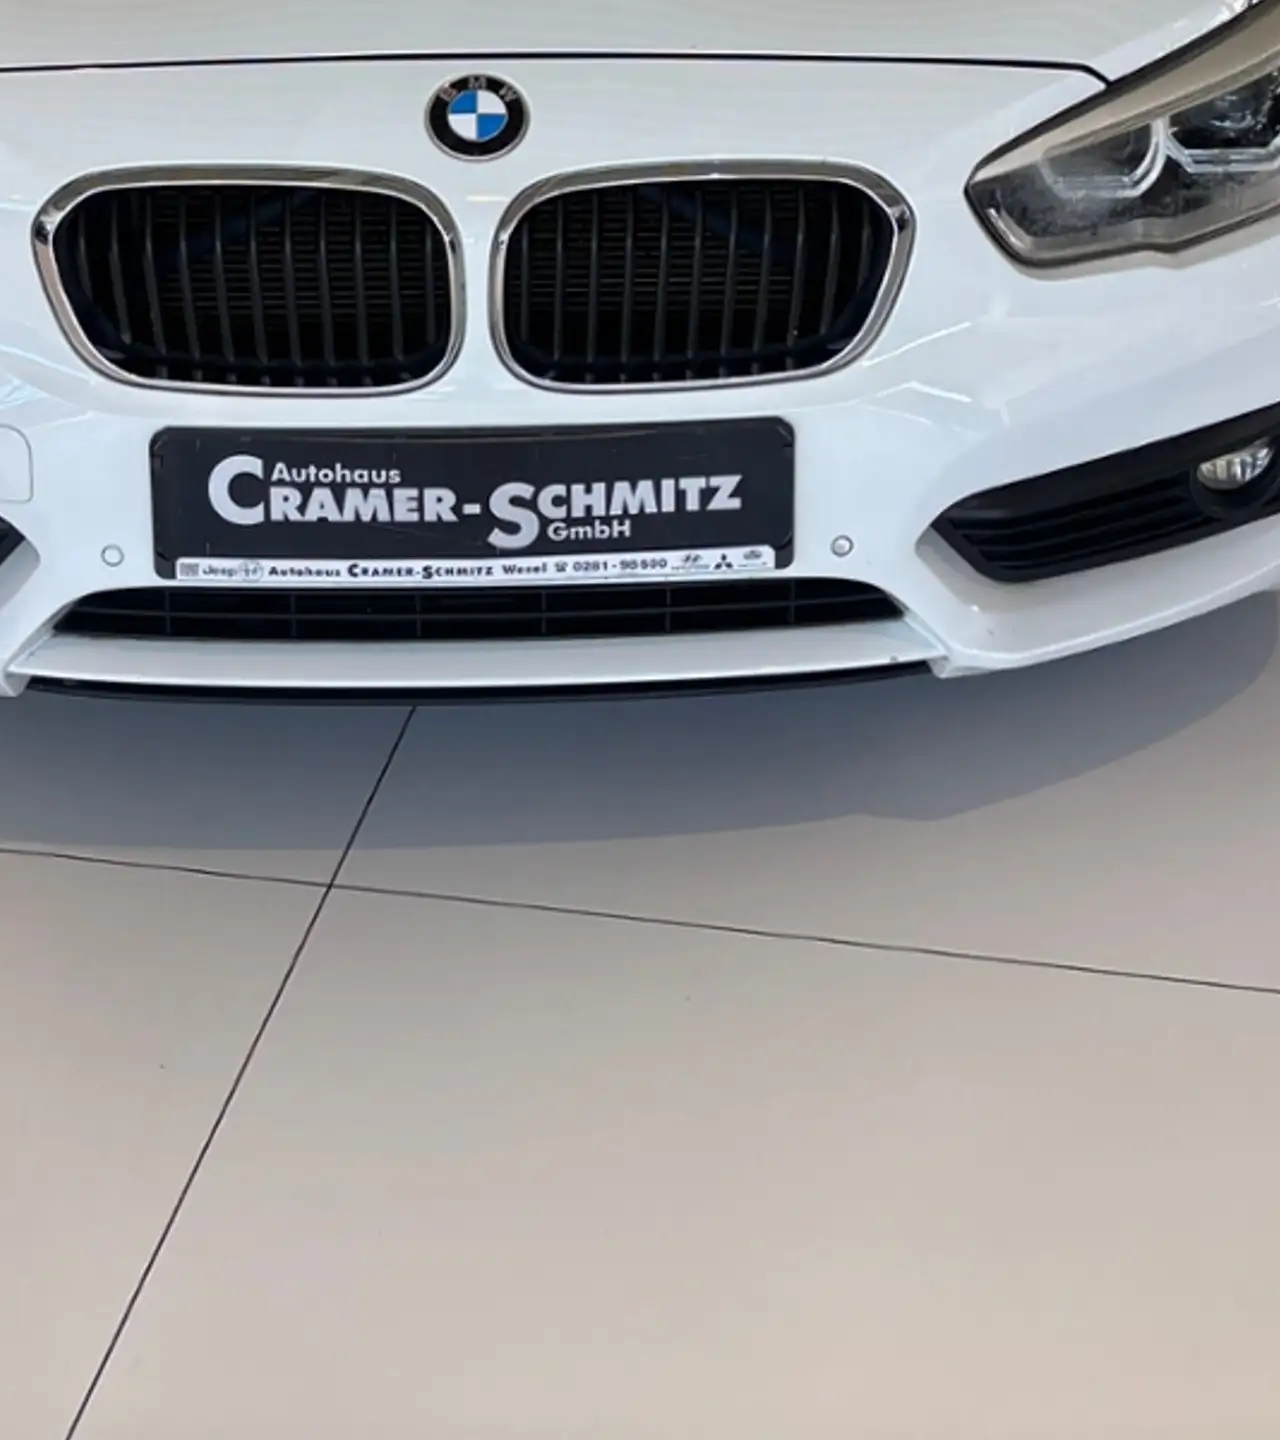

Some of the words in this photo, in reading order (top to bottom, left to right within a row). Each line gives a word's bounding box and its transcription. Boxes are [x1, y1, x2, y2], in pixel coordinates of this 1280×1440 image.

[438, 76, 520, 103] BMW
[271, 462, 402, 484] Autohaus
[546, 519, 632, 541] GmbH
[268, 565, 341, 578] Autohaus
[502, 562, 548, 575] Wesel
